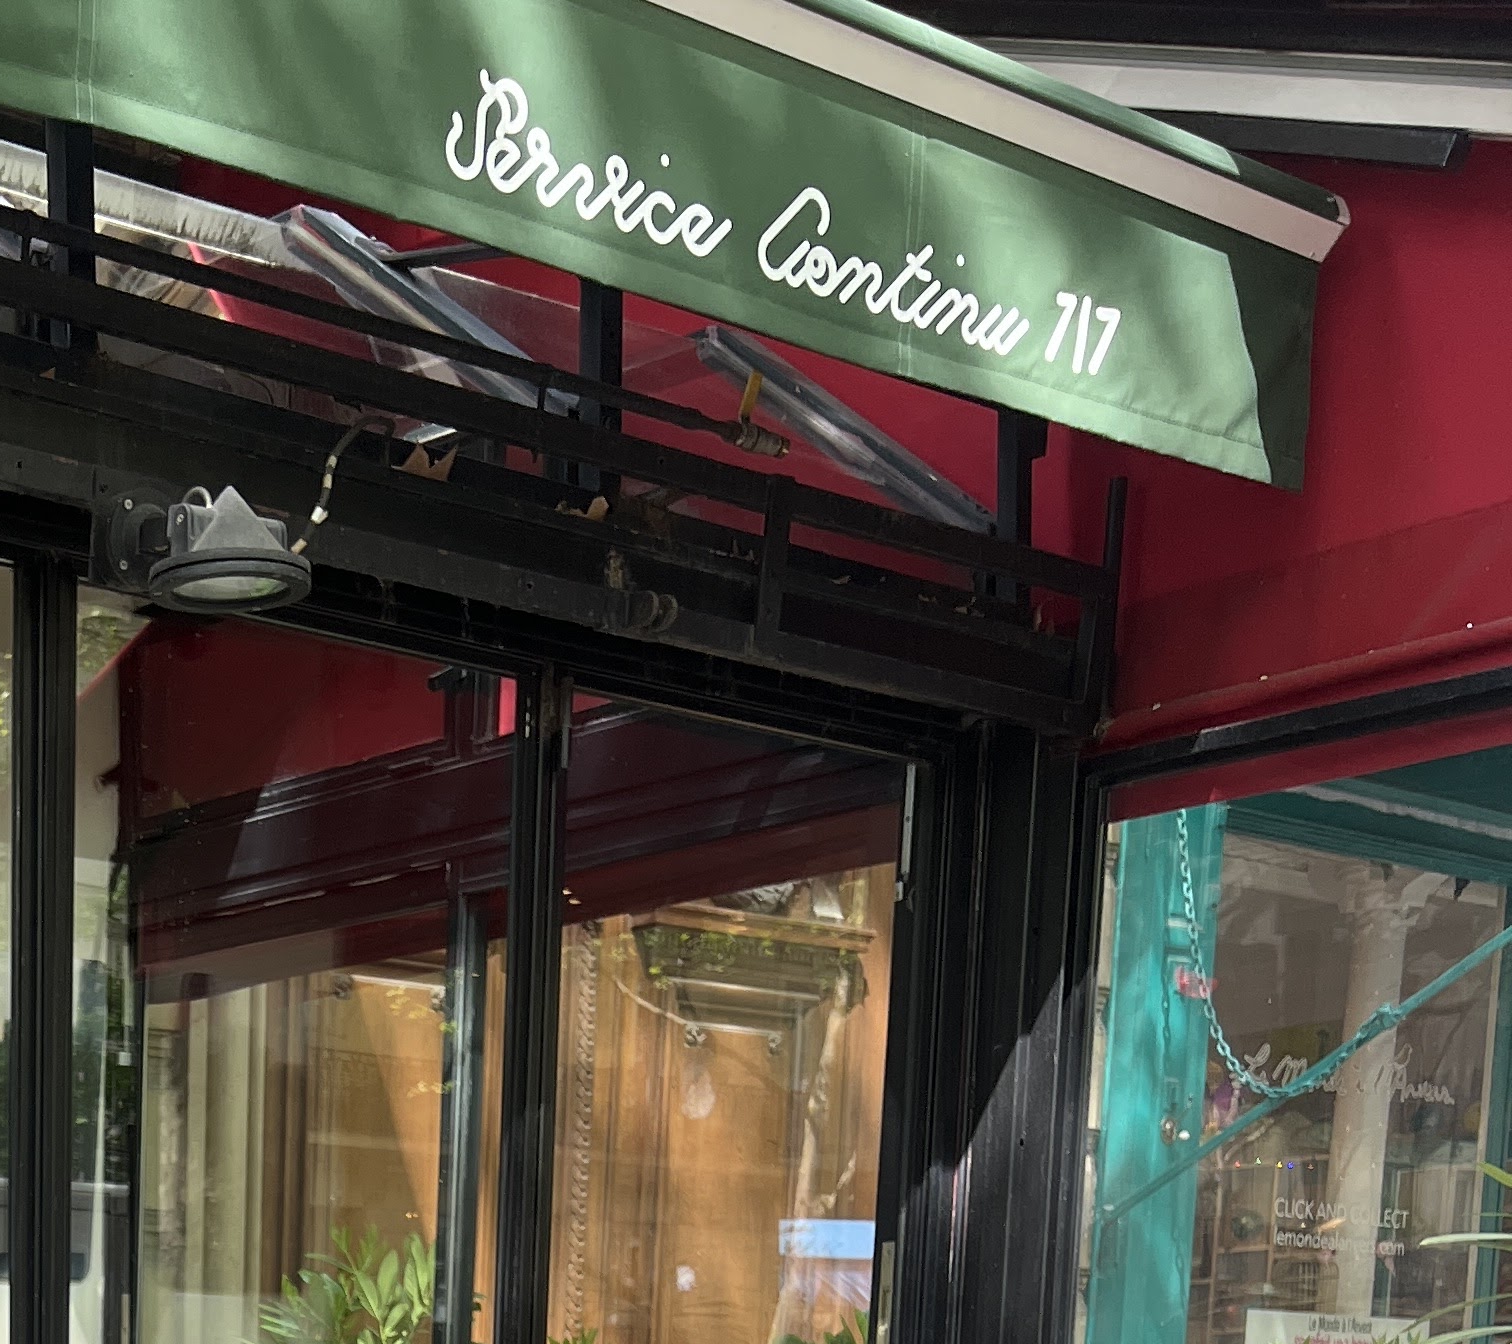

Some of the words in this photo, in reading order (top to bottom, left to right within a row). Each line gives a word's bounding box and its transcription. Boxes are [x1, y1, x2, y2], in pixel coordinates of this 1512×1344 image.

[444, 68, 732, 258] Service
[756, 185, 1030, 357] Continu
[1274, 1196, 1315, 1221] CLICK
[1315, 1201, 1347, 1221] AND
[1349, 1205, 1410, 1230] COLLECT
